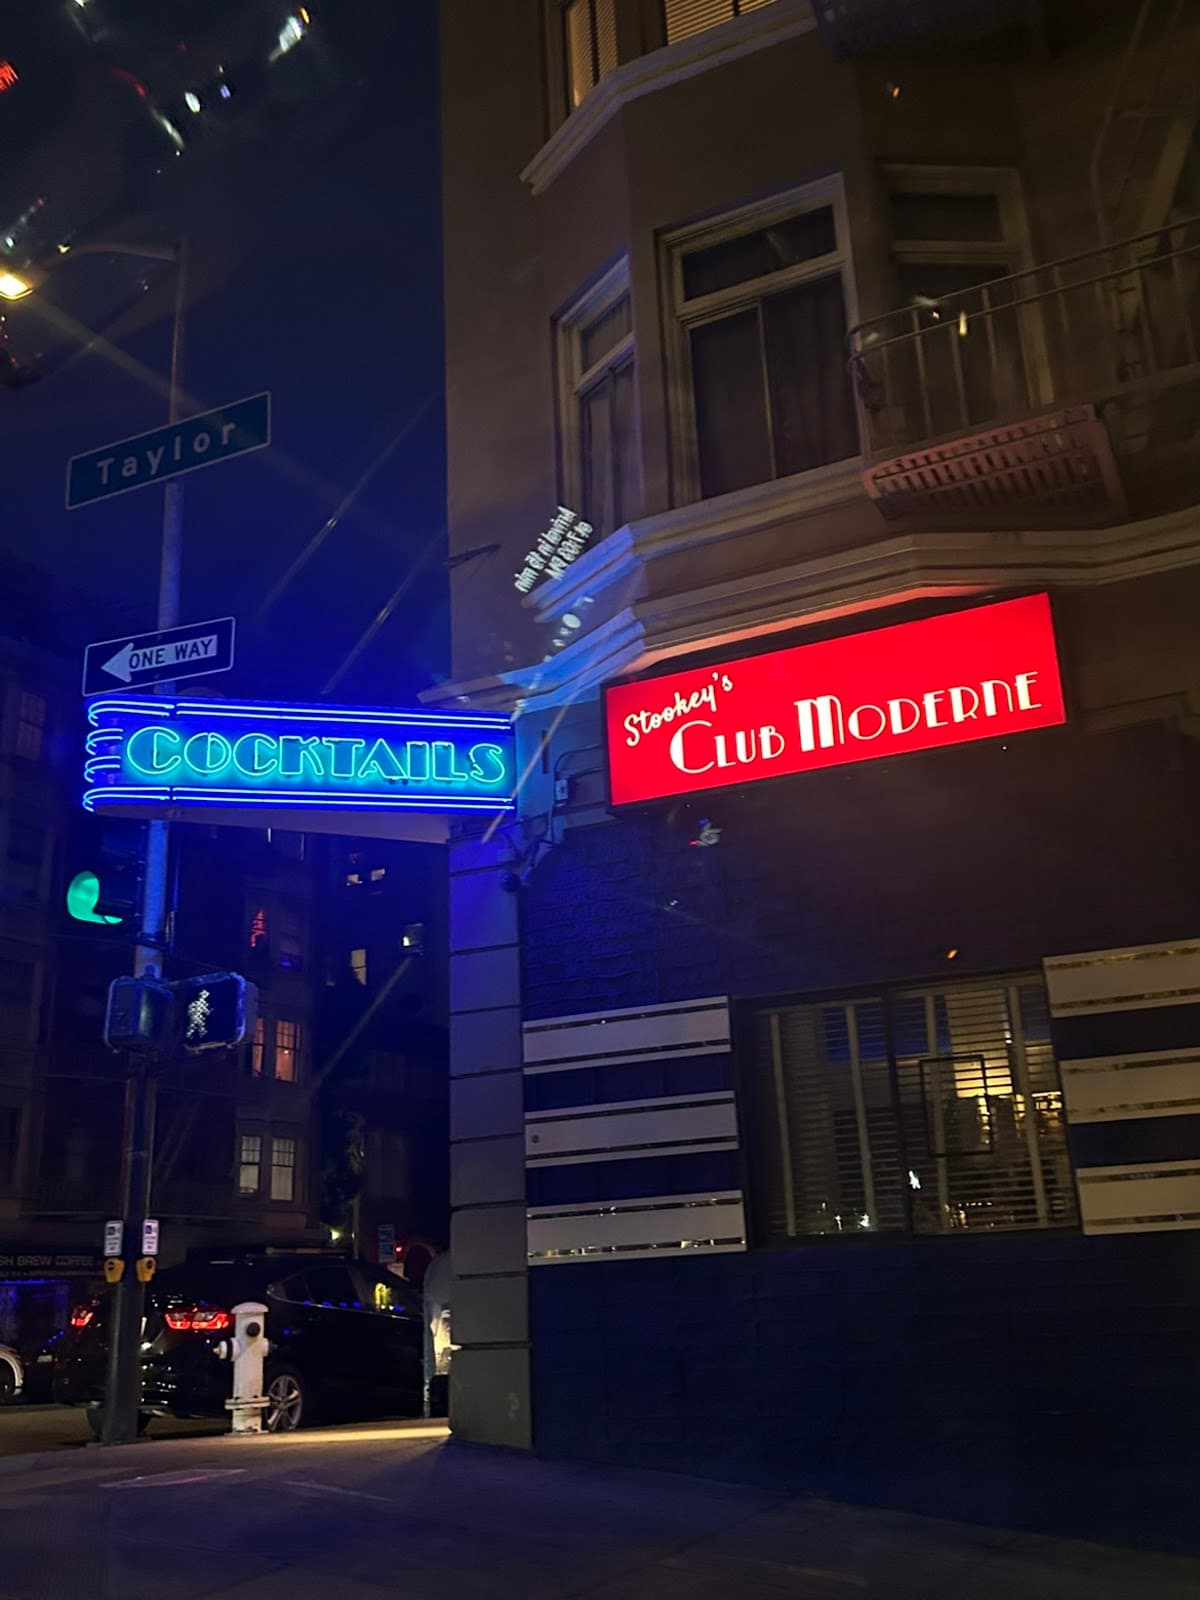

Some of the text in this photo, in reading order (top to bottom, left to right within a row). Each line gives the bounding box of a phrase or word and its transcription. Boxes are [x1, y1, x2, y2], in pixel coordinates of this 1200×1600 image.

[97, 422, 236, 484] Taylor
[129, 638, 214, 670] ONE WAY
[624, 672, 733, 747] Stookey's
[670, 672, 1042, 774] CLUB MODERNE
[127, 726, 506, 783] COCKTAILS
[17, 1256, 53, 1266] BREW
[55, 1255, 94, 1264] COFFEE
